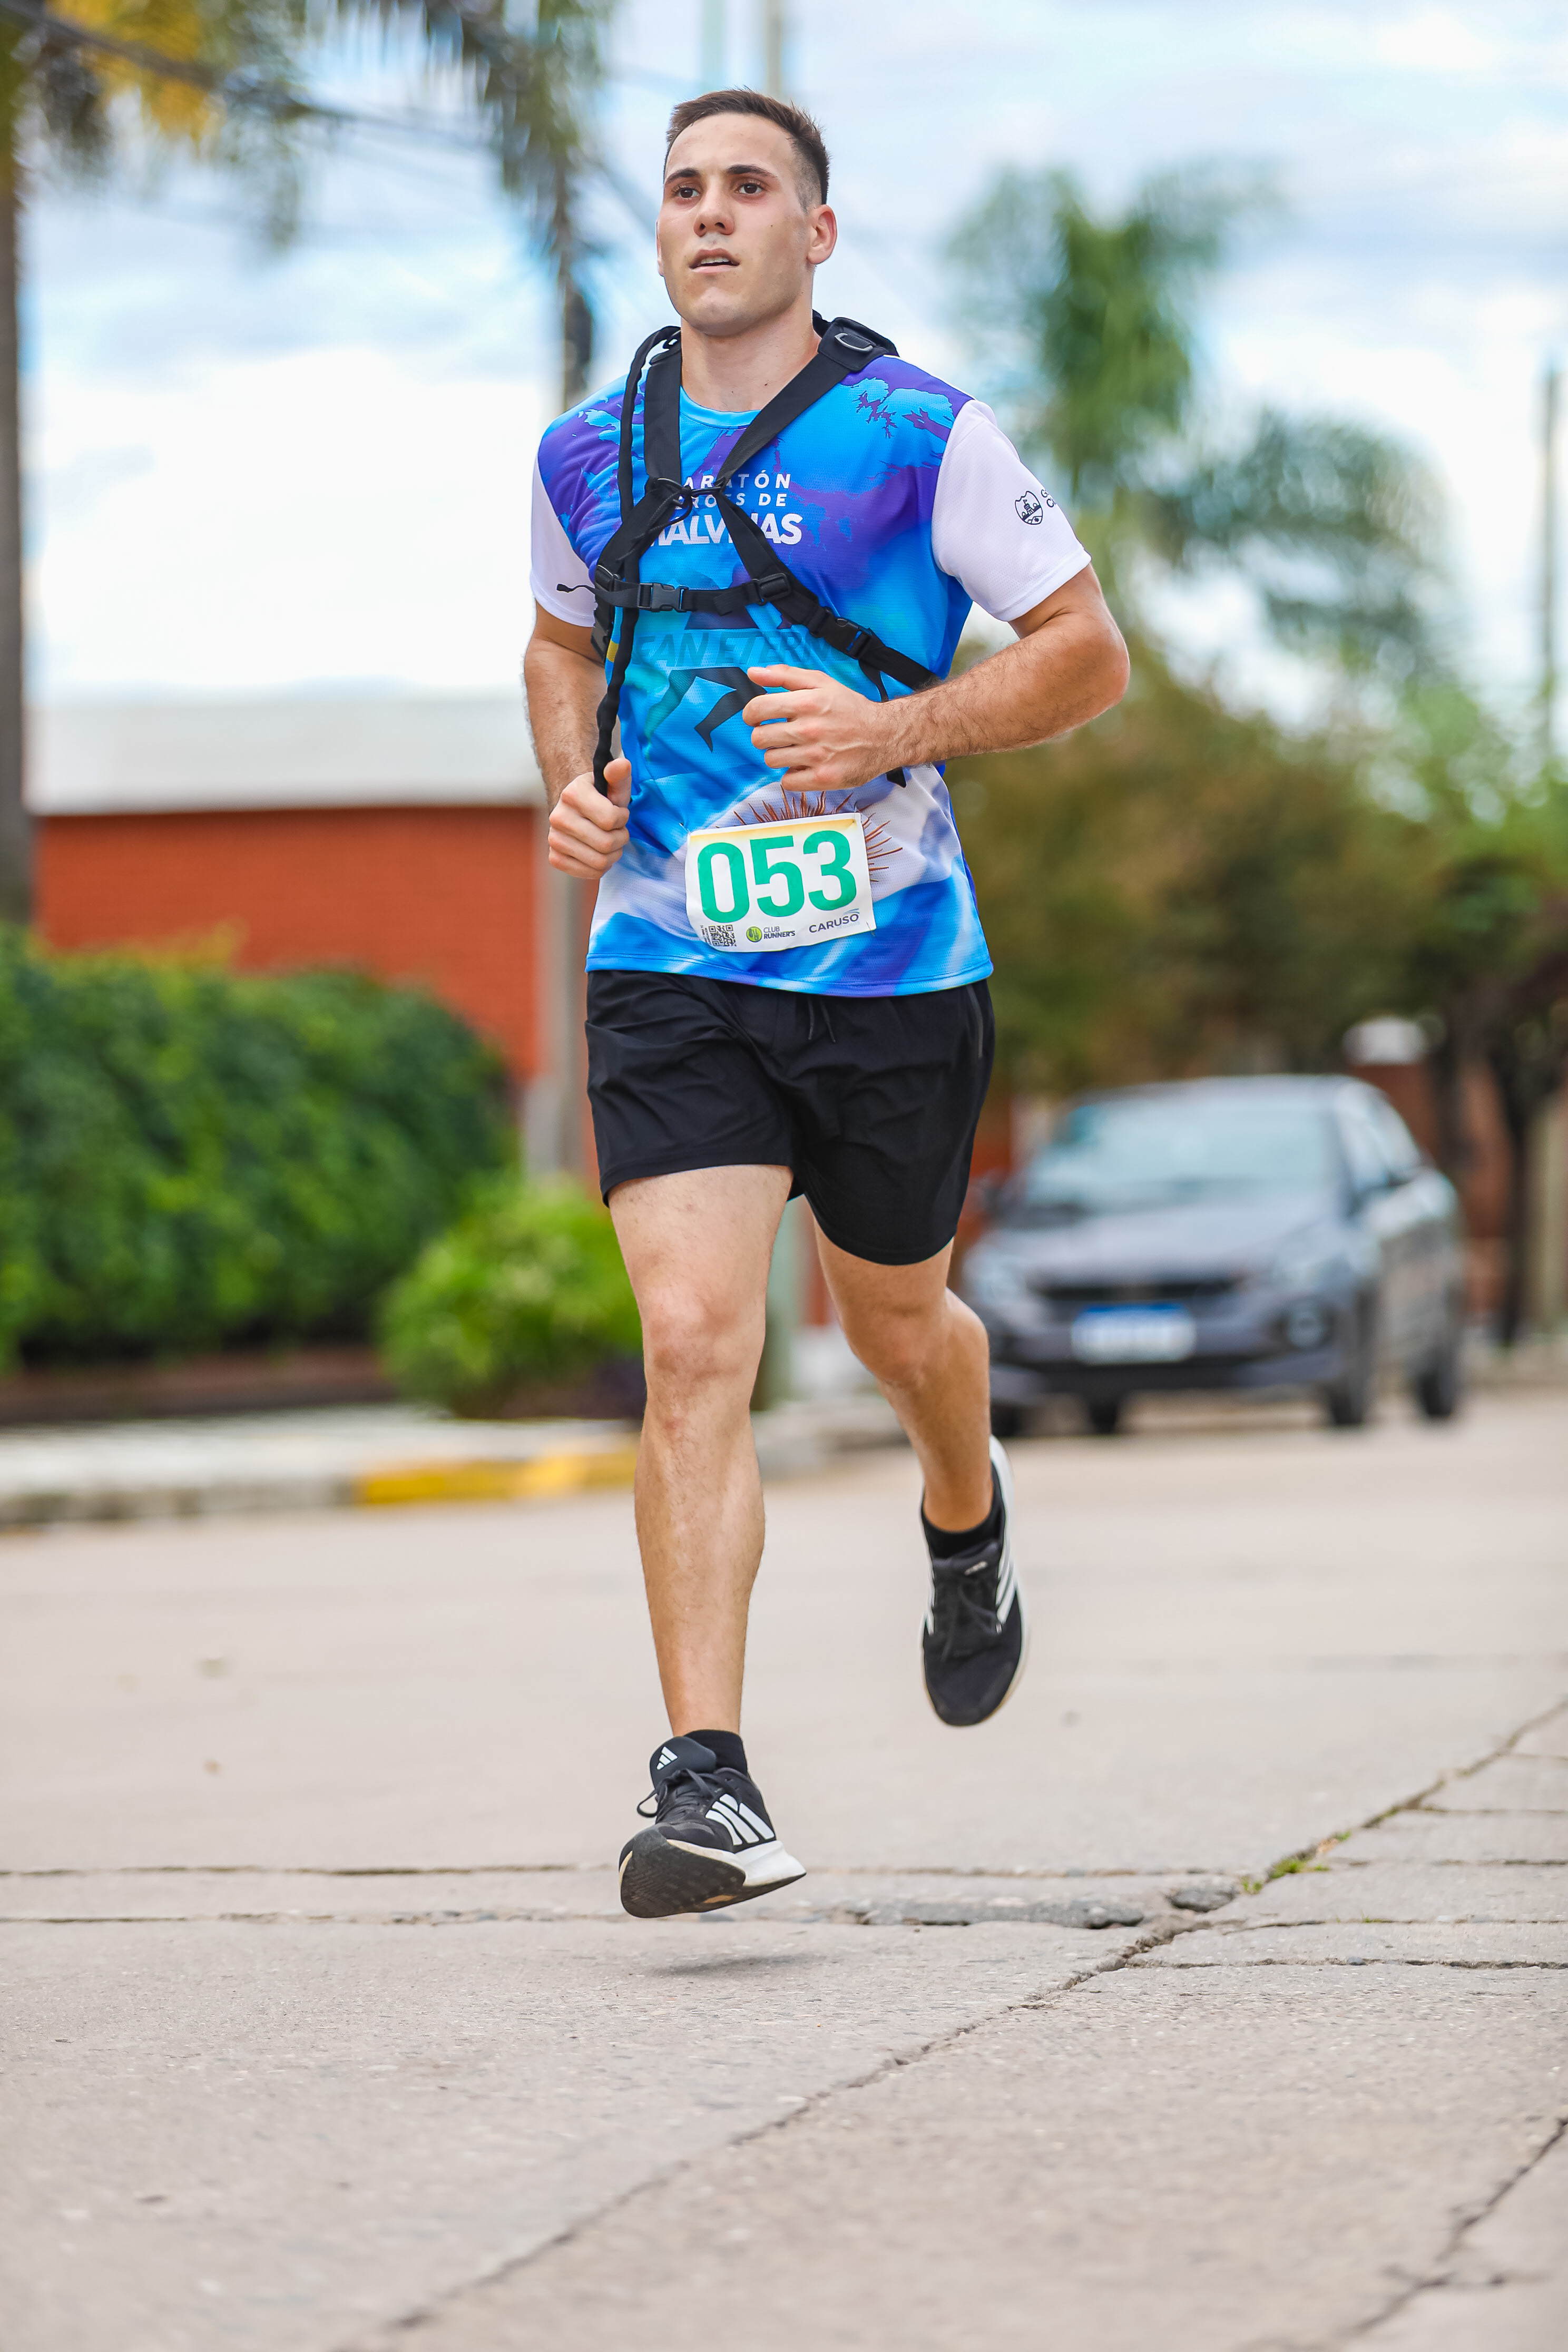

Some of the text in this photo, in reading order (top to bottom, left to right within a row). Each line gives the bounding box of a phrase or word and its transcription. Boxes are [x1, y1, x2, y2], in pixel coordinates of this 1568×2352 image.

[759, 493, 787, 507] DE
[698, 830, 857, 923] 053
[809, 914, 859, 933] CARUSO
